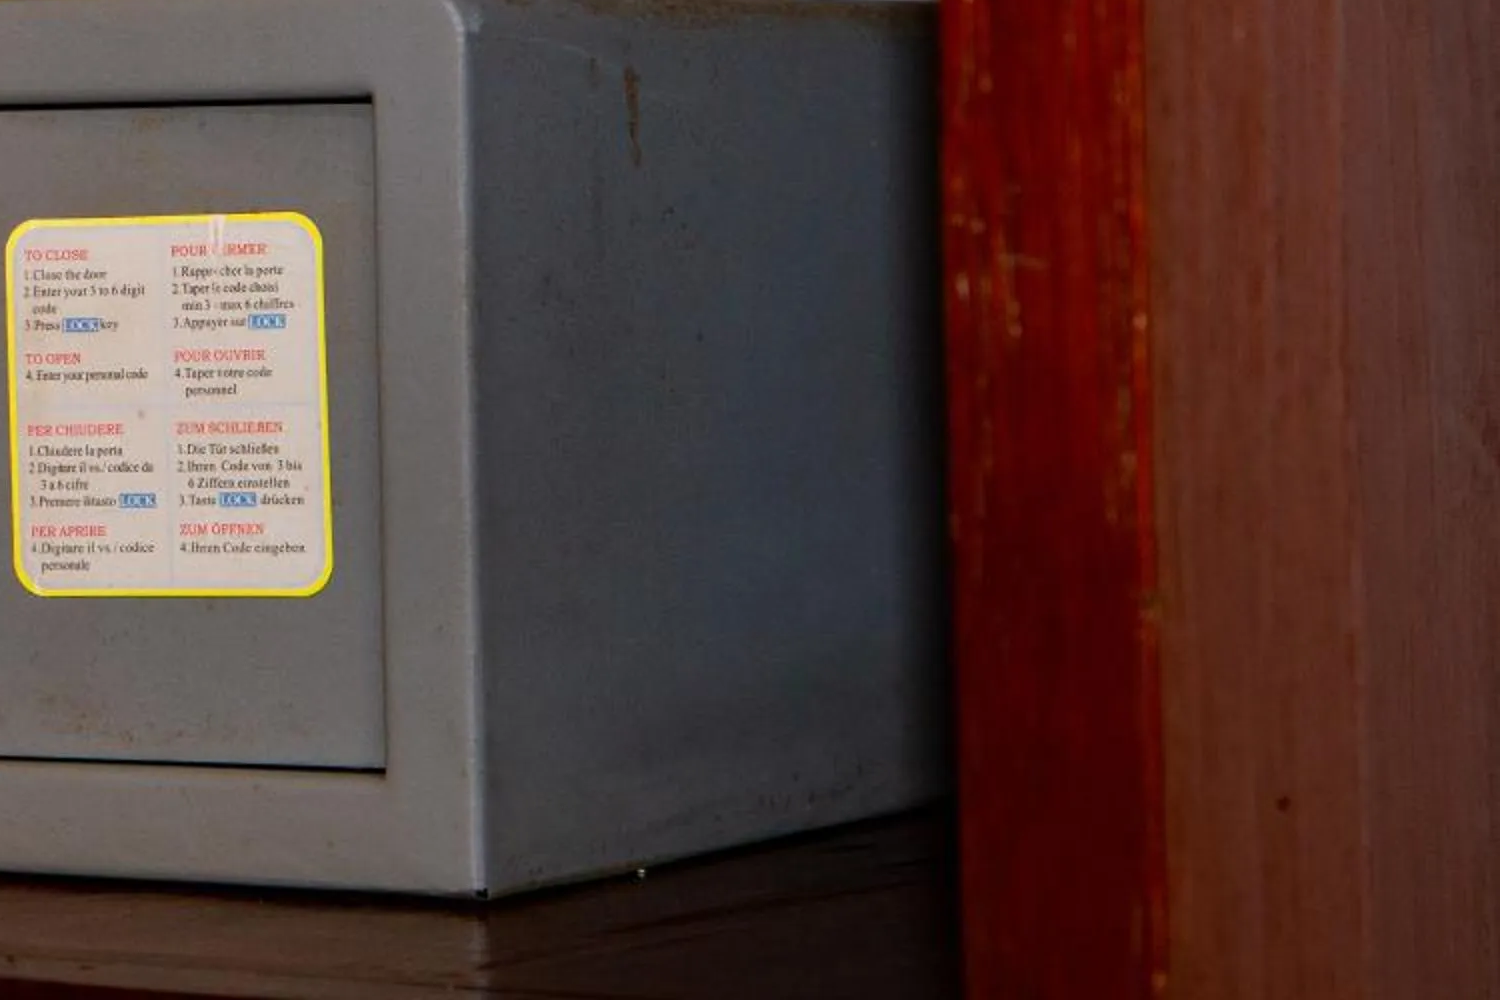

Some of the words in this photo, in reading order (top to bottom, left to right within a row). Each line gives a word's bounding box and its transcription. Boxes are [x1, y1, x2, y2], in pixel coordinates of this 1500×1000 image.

[24, 249, 43, 261] TO
[45, 249, 89, 260] CLOSE
[171, 245, 207, 257] POUR
[65, 268, 80, 280] the
[83, 268, 108, 280] door
[256, 265, 284, 278] porte
[63, 287, 87, 299] your
[120, 283, 145, 298] digit
[223, 282, 247, 293] code
[32, 303, 57, 314] code
[26, 353, 43, 365] TO
[45, 352, 81, 365] OPEN
[173, 349, 211, 362] POUR
[63, 371, 84, 383] your
[85, 368, 124, 383] personal
[125, 368, 148, 380] code
[246, 365, 273, 378] code
[184, 383, 238, 398] personnel
[28, 424, 52, 437] PER
[55, 423, 125, 436] CHIUDERE
[176, 422, 205, 435] ZUM
[85, 444, 95, 456] la
[97, 445, 123, 458] porta
[141, 461, 154, 473] da
[221, 459, 249, 471] Code
[251, 462, 272, 471] von
[285, 459, 303, 471] bis
[66, 478, 89, 490] cifre
[197, 477, 235, 489] Ziffern
[237, 477, 290, 489] einstellen
[31, 525, 57, 537] PER
[180, 522, 207, 536] ZUM
[223, 541, 252, 553] Code
[41, 559, 91, 574] personale
